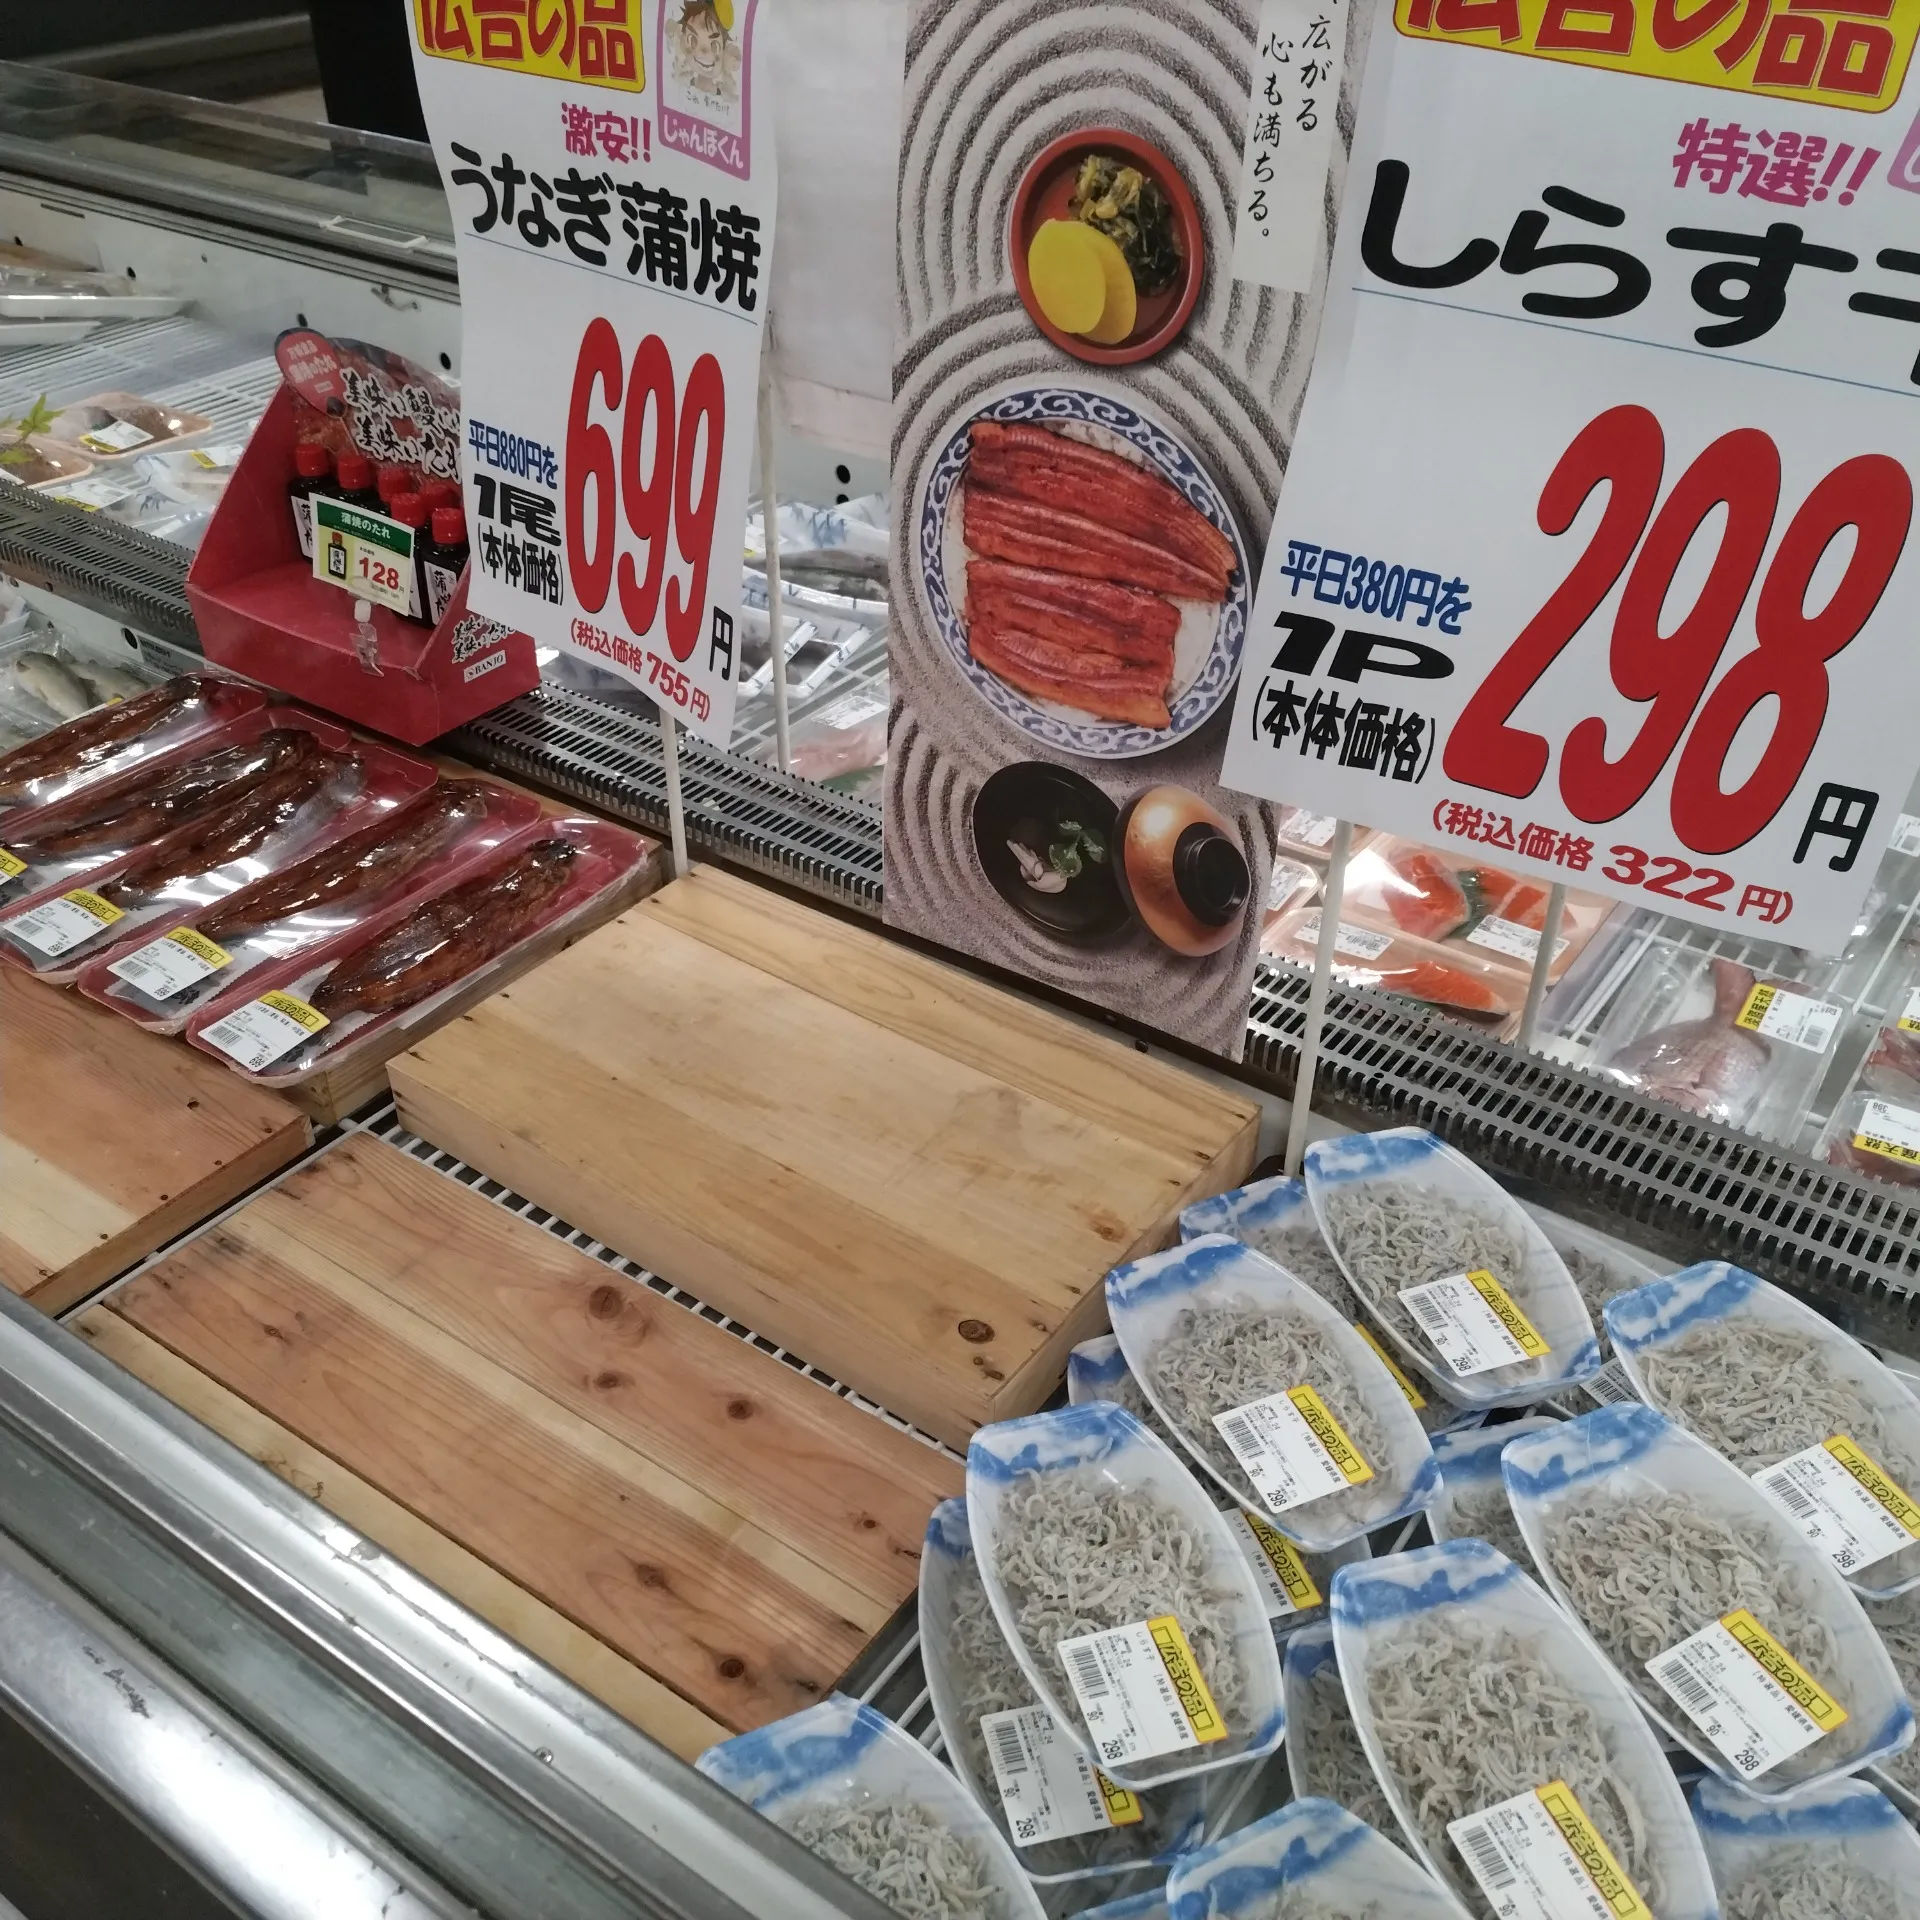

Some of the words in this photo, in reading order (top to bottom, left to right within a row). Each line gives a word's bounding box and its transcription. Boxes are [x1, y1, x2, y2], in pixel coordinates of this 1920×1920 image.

[561, 102, 652, 163] 激安!!
[1248, 32, 1294, 237] 心も満ちる。
[1673, 118, 1882, 207] 特選!!
[451, 142, 761, 311] うなぎ蒲焼
[469, 419, 558, 490] 平日880円を
[473, 473, 561, 547] 1尾
[565, 317, 725, 661] 699
[709, 605, 734, 680] 円
[359, 556, 399, 590] 128
[477, 523, 564, 606] (本体価格)
[1280, 540, 1472, 635] 平日380円を
[1270, 612, 1455, 682] 1P
[1442, 404, 1913, 855] 298
[1792, 782, 1879, 872] 円
[1252, 676, 1437, 784] (本体価格)
[1479, 1286, 1530, 1339] 広告の品
[1451, 1356, 1471, 1371] 298
[1299, 1403, 1352, 1464] 広告の品
[1266, 1489, 1286, 1506] 298
[1841, 1455, 1909, 1518] 広告の品
[1831, 1549, 1855, 1568] 298
[1157, 1640, 1207, 1716] 広告の品
[1741, 1632, 1819, 1707] 広告の品
[1101, 1739, 1122, 1759] 298
[1734, 1749, 1759, 1771] 298
[1015, 1817, 1035, 1838] 298
[1553, 1810, 1625, 1899] 広告の品
